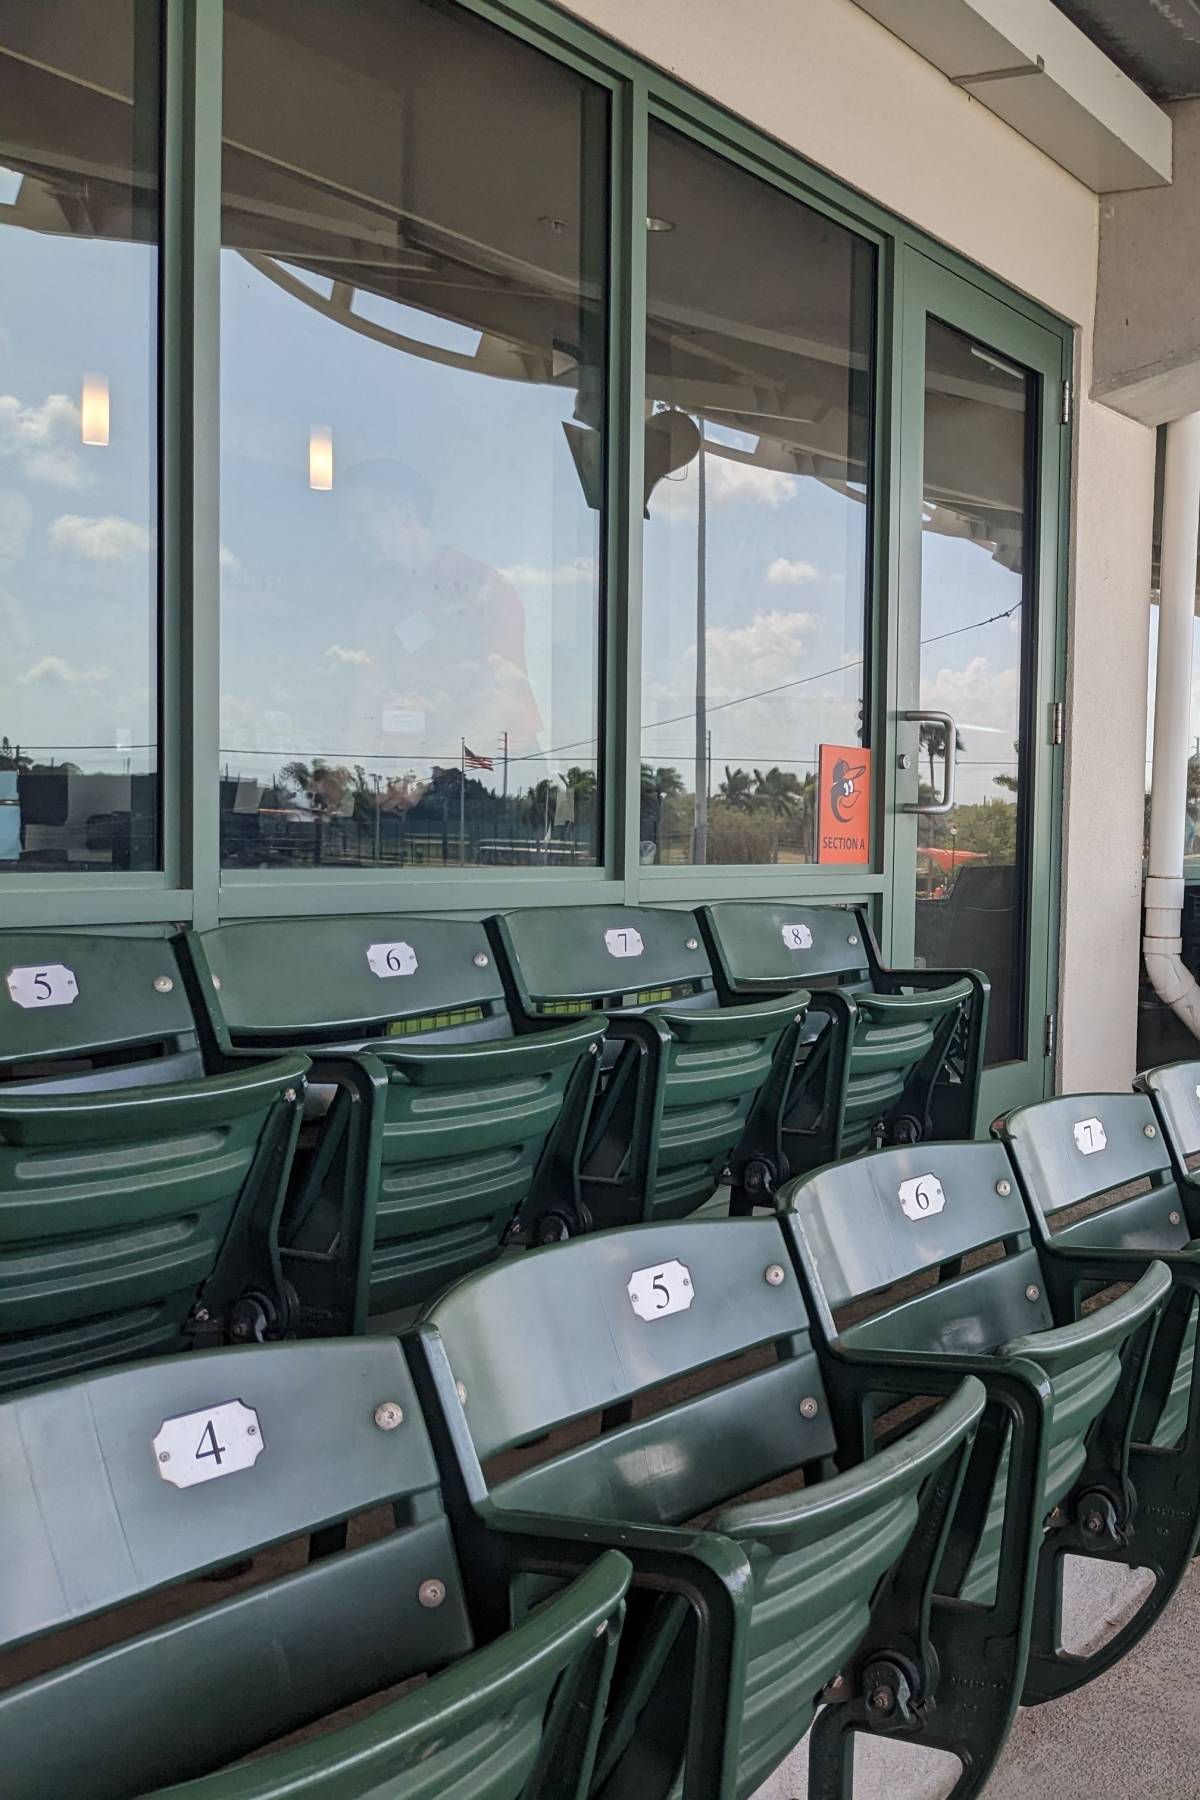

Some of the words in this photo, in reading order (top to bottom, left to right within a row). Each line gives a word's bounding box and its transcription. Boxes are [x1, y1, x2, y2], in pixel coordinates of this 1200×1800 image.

[822, 837, 857, 850] SECTION
[859, 838, 865, 849] A
[617, 933, 628, 953] 7
[791, 928, 802, 945] 8
[386, 948, 401, 972] 6
[34, 973, 53, 1001] 5
[1083, 1124, 1094, 1147] 7
[915, 1182, 930, 1210] 6
[652, 1273, 670, 1310] 5
[195, 1420, 226, 1465] 4
